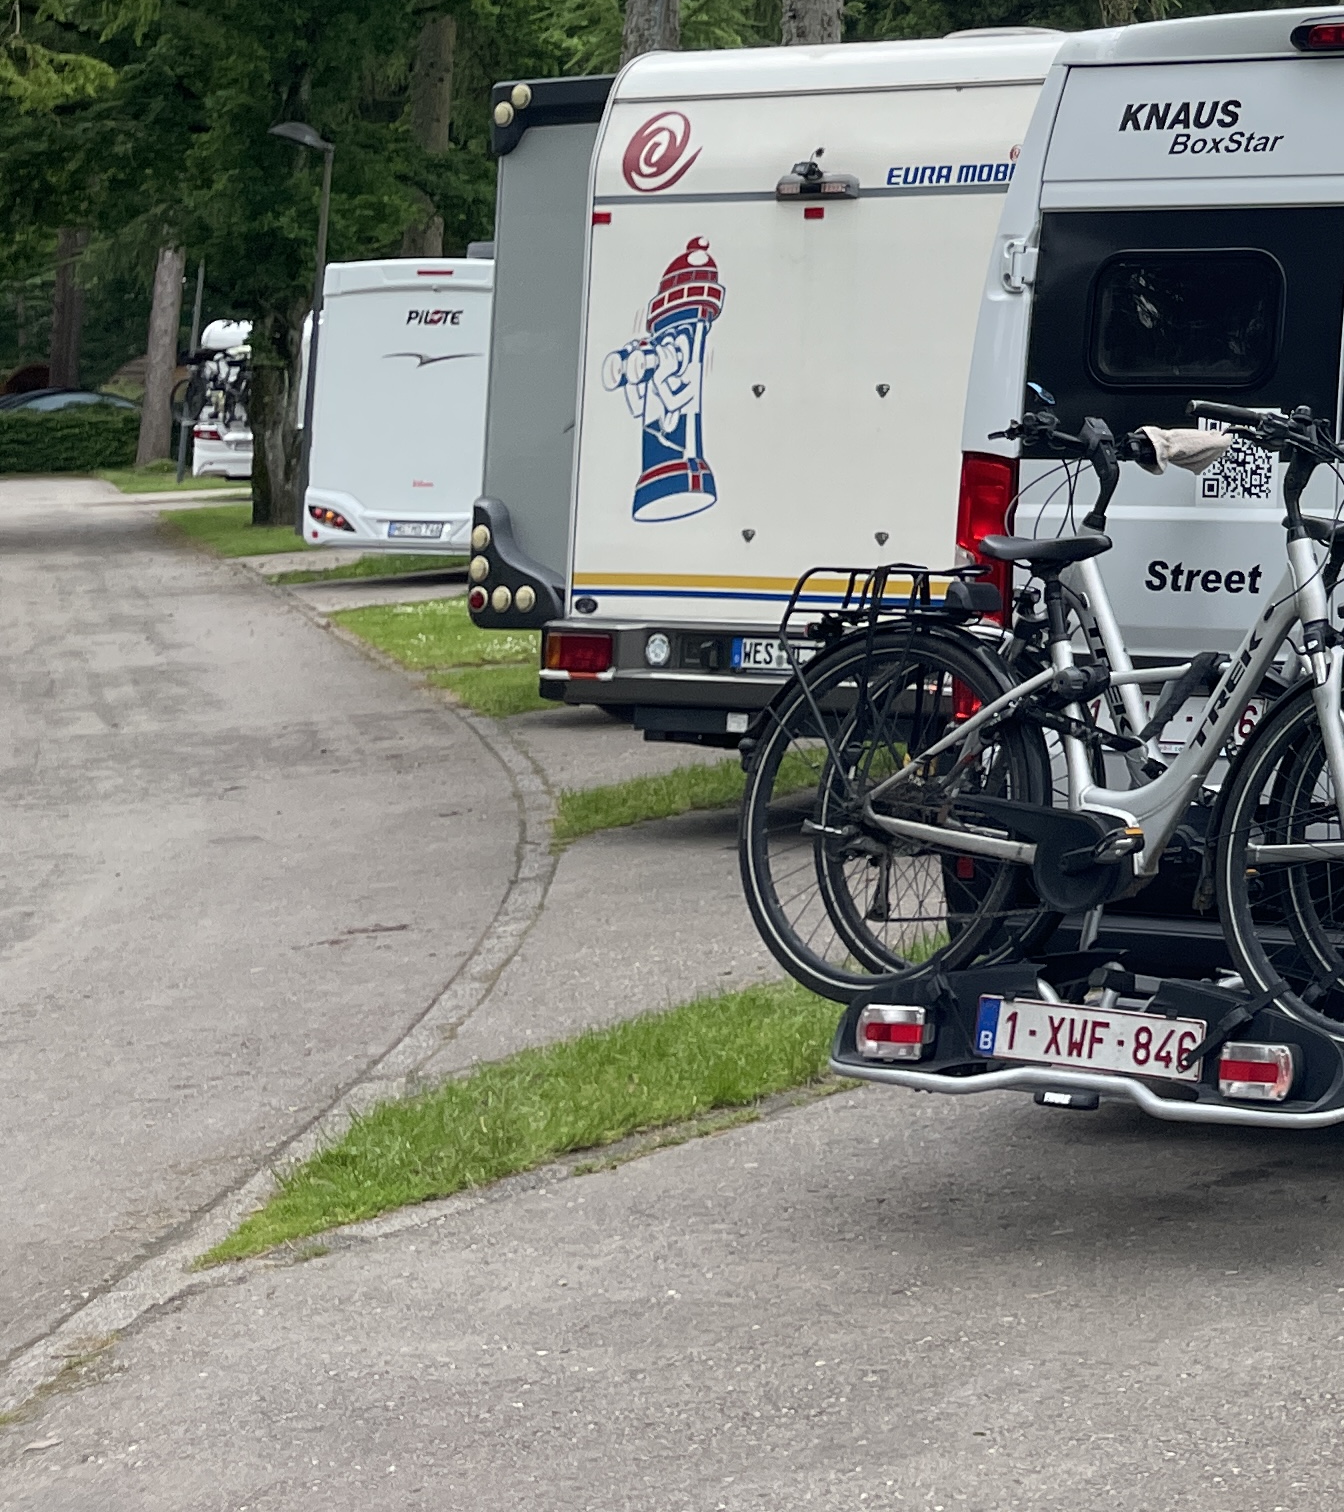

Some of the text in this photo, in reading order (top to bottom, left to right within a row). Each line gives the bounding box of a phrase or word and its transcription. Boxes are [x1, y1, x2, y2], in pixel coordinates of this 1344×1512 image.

[1118, 99, 1242, 132] KNAUS
[1168, 131, 1285, 155] BoxStar
[886, 163, 1016, 186] EURA MOBI
[1145, 560, 1263, 594] Street
[743, 641, 774, 665] WES
[1188, 628, 1263, 749] TREK
[979, 1031, 993, 1050] B
